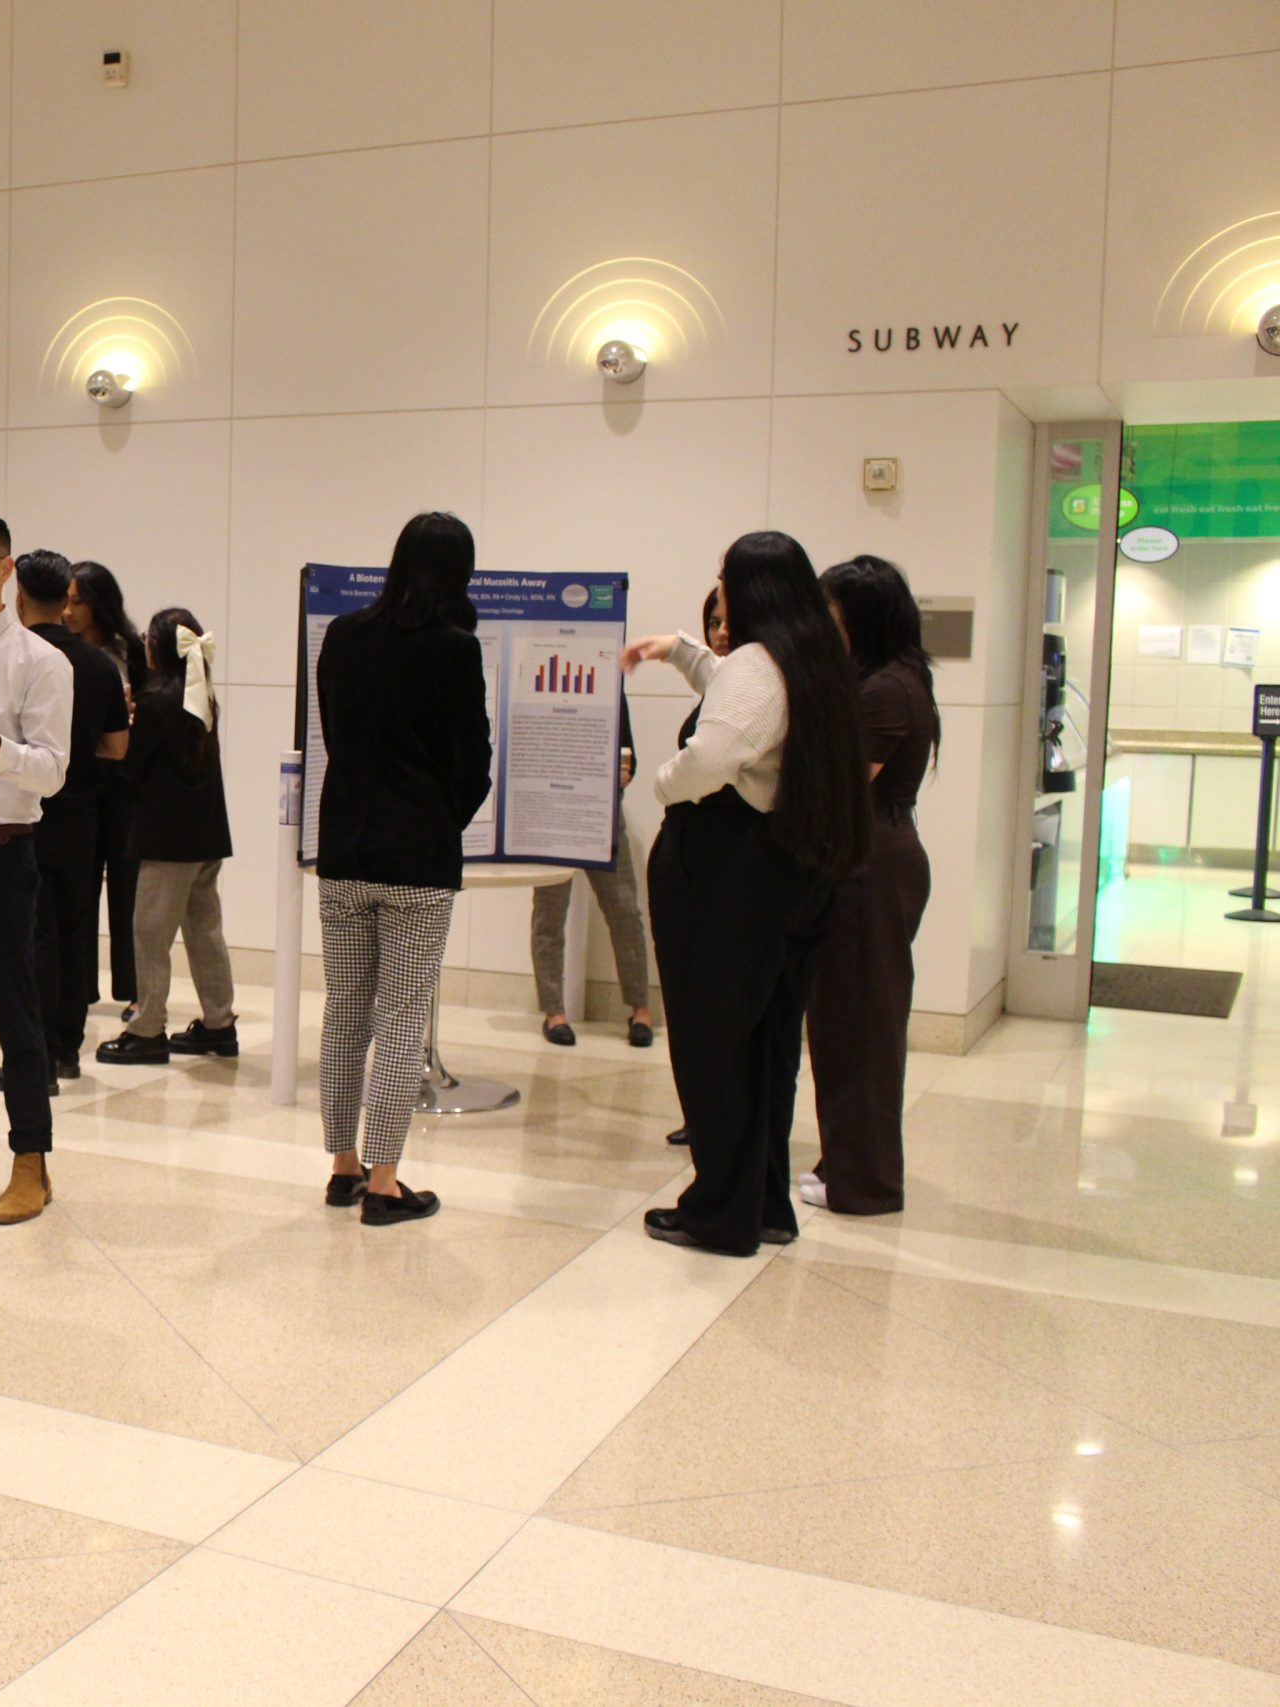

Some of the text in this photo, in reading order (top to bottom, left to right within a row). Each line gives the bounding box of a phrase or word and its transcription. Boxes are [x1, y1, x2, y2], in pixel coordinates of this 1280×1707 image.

[847, 322, 1020, 353] SUBWAY
[1153, 506, 1169, 514] eat
[1170, 504, 1197, 514] fresh
[1199, 505, 1216, 514] eat
[1217, 503, 1244, 513] fresh
[1245, 504, 1262, 513] eat
[348, 573, 355, 583] A
[483, 577, 520, 587] Mucositis
[521, 578, 547, 589] Away
[1260, 705, 1280, 717] Here
